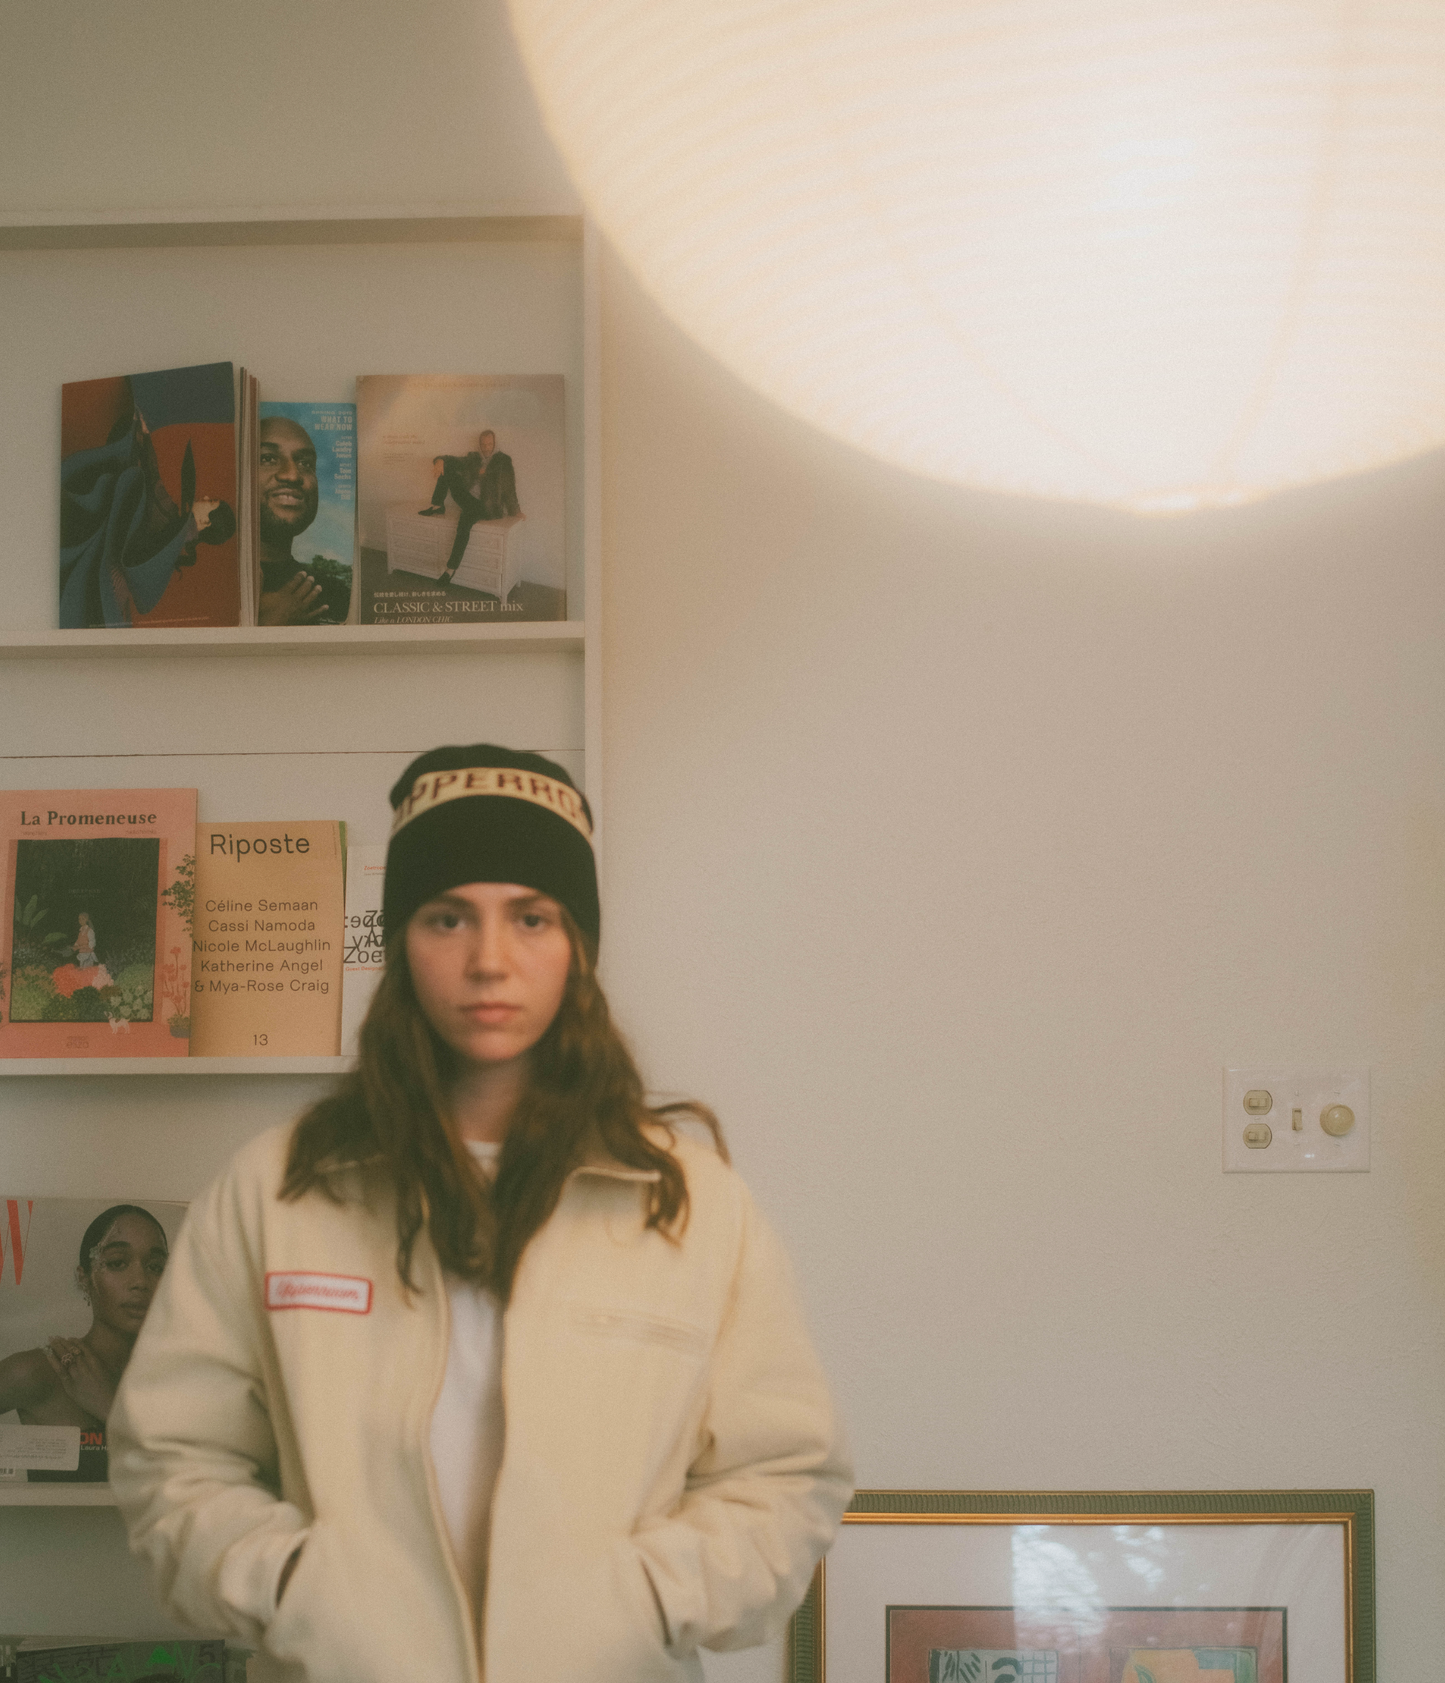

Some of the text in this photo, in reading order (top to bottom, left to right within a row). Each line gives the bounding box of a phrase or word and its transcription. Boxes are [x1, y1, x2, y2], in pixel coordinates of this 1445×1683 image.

[320, 416, 353, 424] WHAT TO
[373, 600, 524, 614] CLASSIC & STREET mix
[396, 616, 431, 624] LONDON
[20, 811, 157, 826] La Promeneuse
[210, 833, 310, 863] Riposte
[205, 899, 319, 912] Céline Semaan
[208, 919, 316, 932] Cassi Namoda
[193, 939, 331, 954] Nicole McLaughlin
[201, 959, 323, 974] Katherine Angel
[194, 978, 330, 995] & Mya-Rose Craig
[253, 1033, 269, 1047] 13
